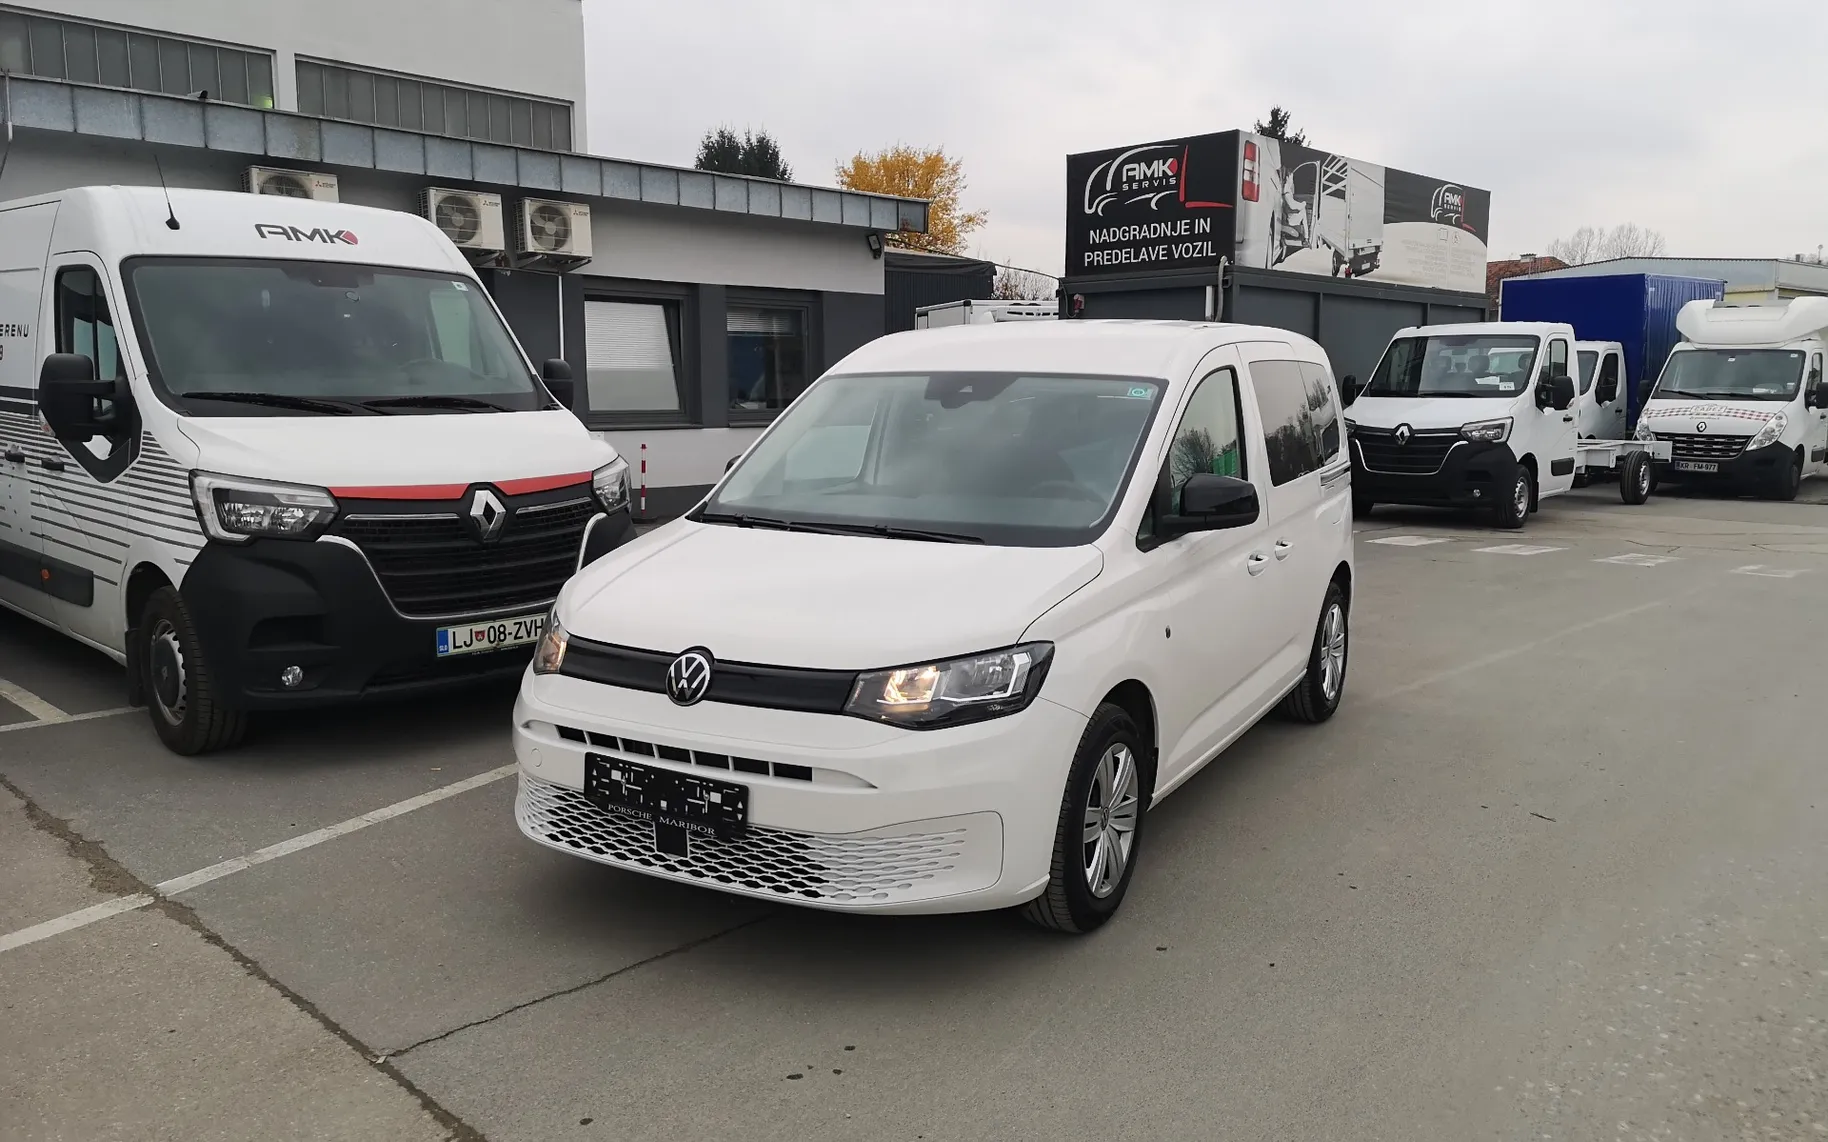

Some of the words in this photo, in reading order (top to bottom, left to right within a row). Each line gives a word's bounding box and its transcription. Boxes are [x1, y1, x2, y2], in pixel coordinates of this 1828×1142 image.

[1123, 158, 1176, 182] AMK
[1122, 177, 1176, 191] SERVIS
[1444, 192, 1462, 206] AMK
[254, 223, 358, 246] AMK
[1089, 219, 1191, 244] NADGRADNJE
[1194, 217, 1211, 235] IN
[1084, 244, 1168, 267] PREDELAVE
[1171, 241, 1217, 259] VOZIL
[452, 628, 474, 650] LJ
[607, 803, 653, 821] PORSCHE
[659, 816, 715, 835] MARIBOR
